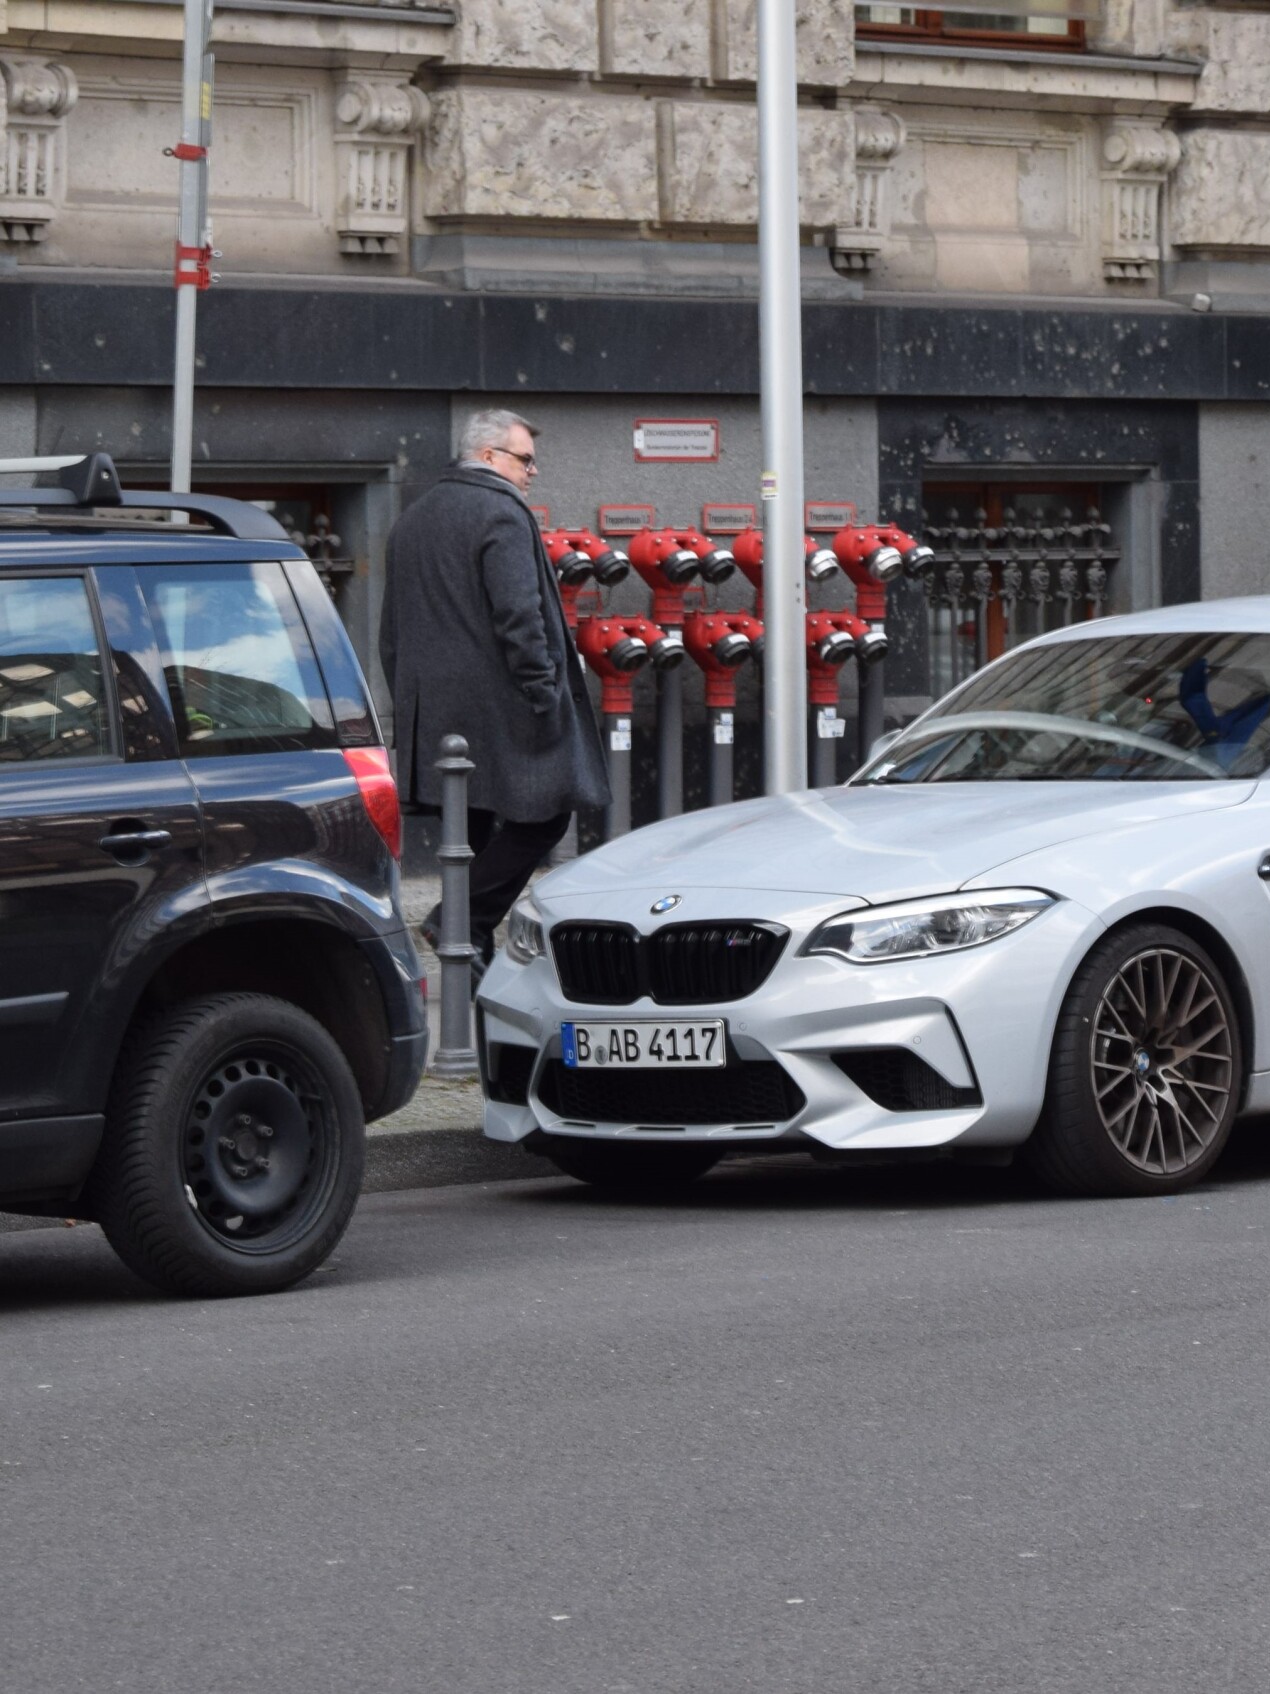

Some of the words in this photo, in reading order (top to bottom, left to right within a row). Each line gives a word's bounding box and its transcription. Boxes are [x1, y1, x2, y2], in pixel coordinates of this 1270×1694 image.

[576, 1028, 592, 1062] B
[608, 1028, 641, 1062] AB
[649, 1027, 717, 1062] 4117
